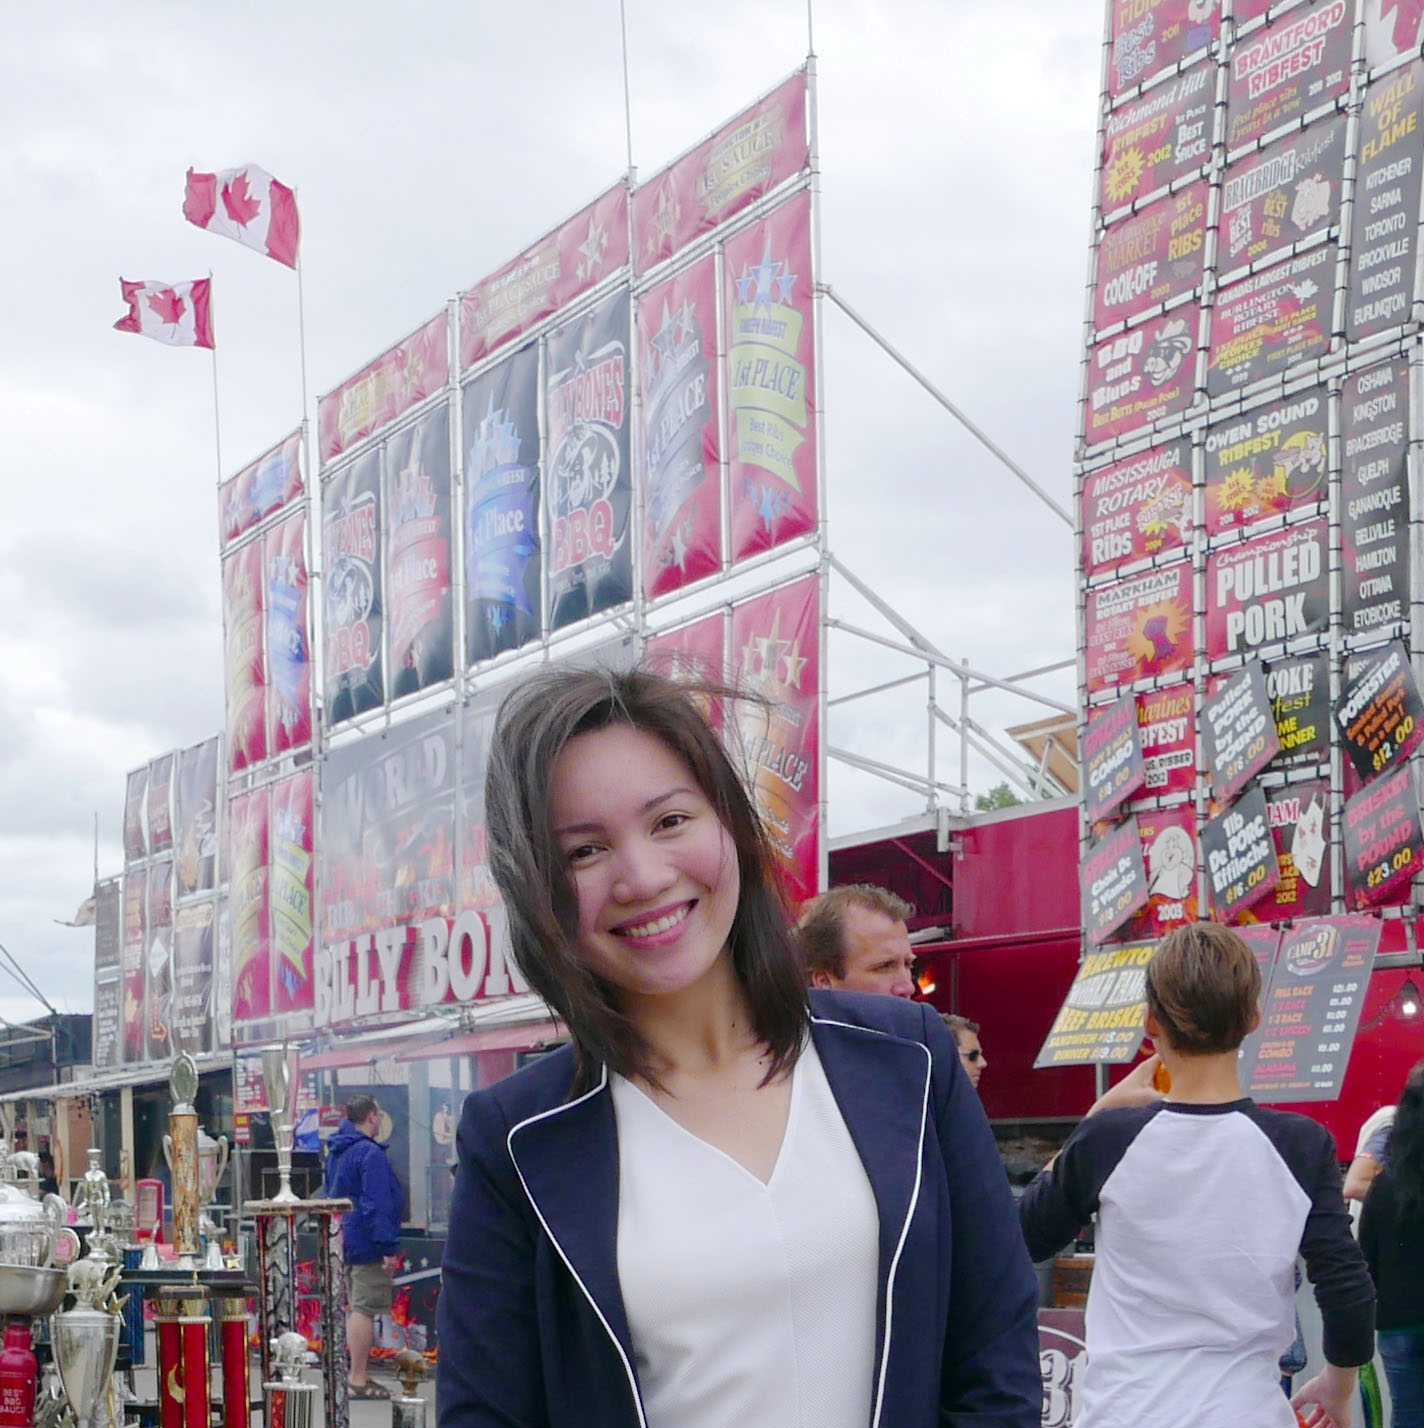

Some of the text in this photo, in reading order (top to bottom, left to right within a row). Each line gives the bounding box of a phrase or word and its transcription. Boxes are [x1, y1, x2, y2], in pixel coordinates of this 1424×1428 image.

[1235, 0, 1346, 81] BRANTFORD
[1249, 35, 1326, 100] RIBFEST
[1107, 69, 1208, 134] Richmond Hill
[1370, 73, 1415, 117] WALL
[1378, 102, 1402, 131] OF
[1361, 111, 1417, 165] FLAME
[1168, 228, 1203, 262] RIBS
[1365, 212, 1406, 241] TORONTO
[1291, 249, 1327, 274] RIBFEST
[1358, 237, 1409, 271] BROCKVILLE
[1104, 261, 1157, 307] COOK-OFF
[1220, 282, 1295, 320] BURLINGTON
[1361, 266, 1401, 296] WINDSOR
[1098, 331, 1143, 369] BBQ
[1106, 356, 1132, 382] and
[575, 356, 624, 429] BONES
[751, 357, 801, 400] PLACE
[1092, 375, 1142, 410] Blues
[1205, 397, 1319, 452] OWEN SOUND
[1353, 392, 1396, 424] KINGSTON
[1219, 429, 1281, 466] RIBFEST
[1346, 421, 1403, 457] BRACEBRIDGE
[1092, 448, 1180, 497] MISSISSAUGA
[1358, 457, 1389, 486] GUELPH
[1096, 474, 1168, 518] ROTARY
[550, 498, 615, 577] BBQ
[1216, 528, 1318, 567] Championship
[1217, 541, 1320, 608] PULLED
[1356, 546, 1396, 572] HAMILTON
[1098, 571, 1178, 606] MARKHAM
[1360, 574, 1393, 599] OTTAWA
[1096, 600, 1134, 620] ROTARY
[1226, 592, 1307, 651] PORK
[1353, 600, 1401, 628] ETOBICOKE
[1208, 672, 1252, 723] Pulled
[1338, 651, 1400, 728] PORKSTER
[1213, 690, 1253, 735] PORK
[1215, 707, 1259, 752] by the
[1215, 714, 1266, 771] POUND
[1373, 715, 1414, 771] $12.00
[760, 742, 808, 791] PLACE
[1090, 740, 1134, 787] COMBO
[1347, 768, 1411, 828] BRISKET
[1209, 815, 1266, 873] De PORC
[1357, 818, 1413, 871] POUND
[1358, 804, 1405, 845] by the
[1368, 847, 1412, 888] $23.00
[313, 926, 412, 1028] BILLY
[418, 909, 531, 1005] BON
[1080, 946, 1158, 981] BREWTO
[1053, 1006, 1089, 1033] BEEF
[0, 1406, 25, 1415] SAUCE
[2, 1389, 23, 1397] BEST
[4, 1397, 22, 1405] BBQ
